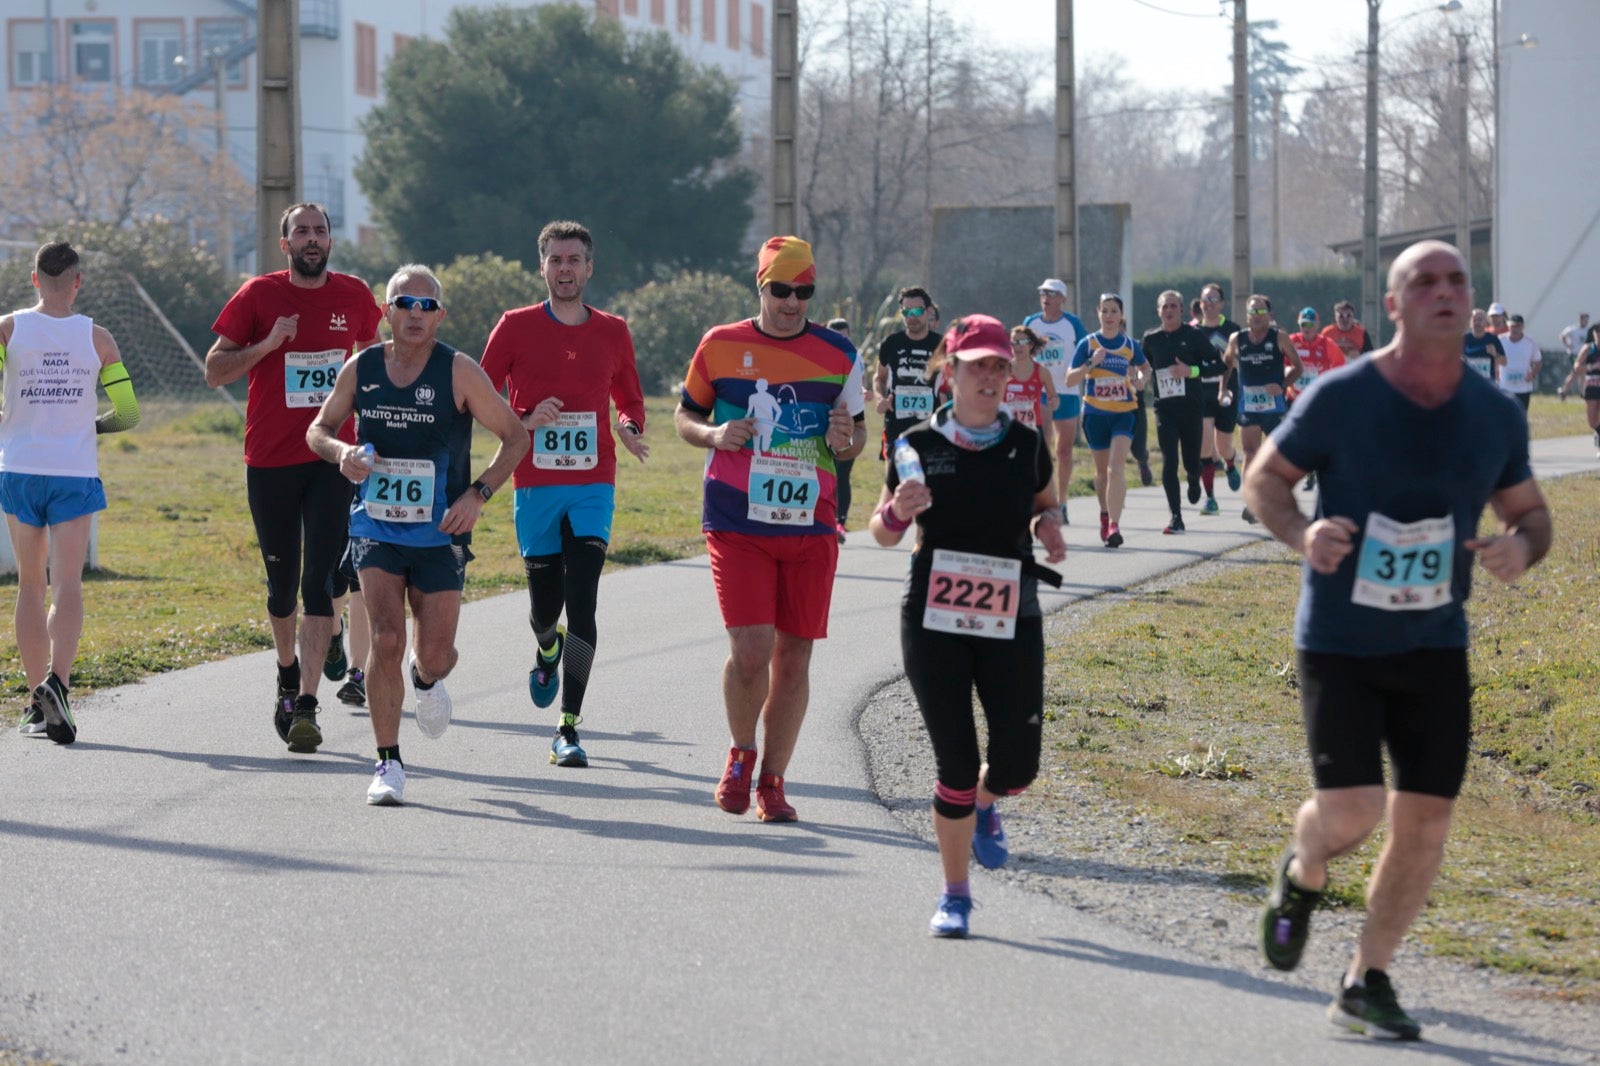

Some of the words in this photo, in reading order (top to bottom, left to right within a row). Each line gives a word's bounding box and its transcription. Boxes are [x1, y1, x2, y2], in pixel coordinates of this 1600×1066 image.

[42, 359, 69, 367] NADA
[19, 369, 35, 377] QUE
[297, 367, 337, 389] 798
[20, 387, 84, 398] FÁCILMENTE
[419, 388, 431, 399] 30
[1096, 386, 1125, 397] 2241
[903, 396, 927, 408] 673
[361, 409, 391, 420] PAZITO
[402, 413, 435, 423] PAZITO
[545, 430, 587, 451] 816
[376, 477, 421, 502] 216
[763, 479, 808, 504] 104
[1376, 549, 1440, 581] 379
[933, 576, 1011, 612] 2221
